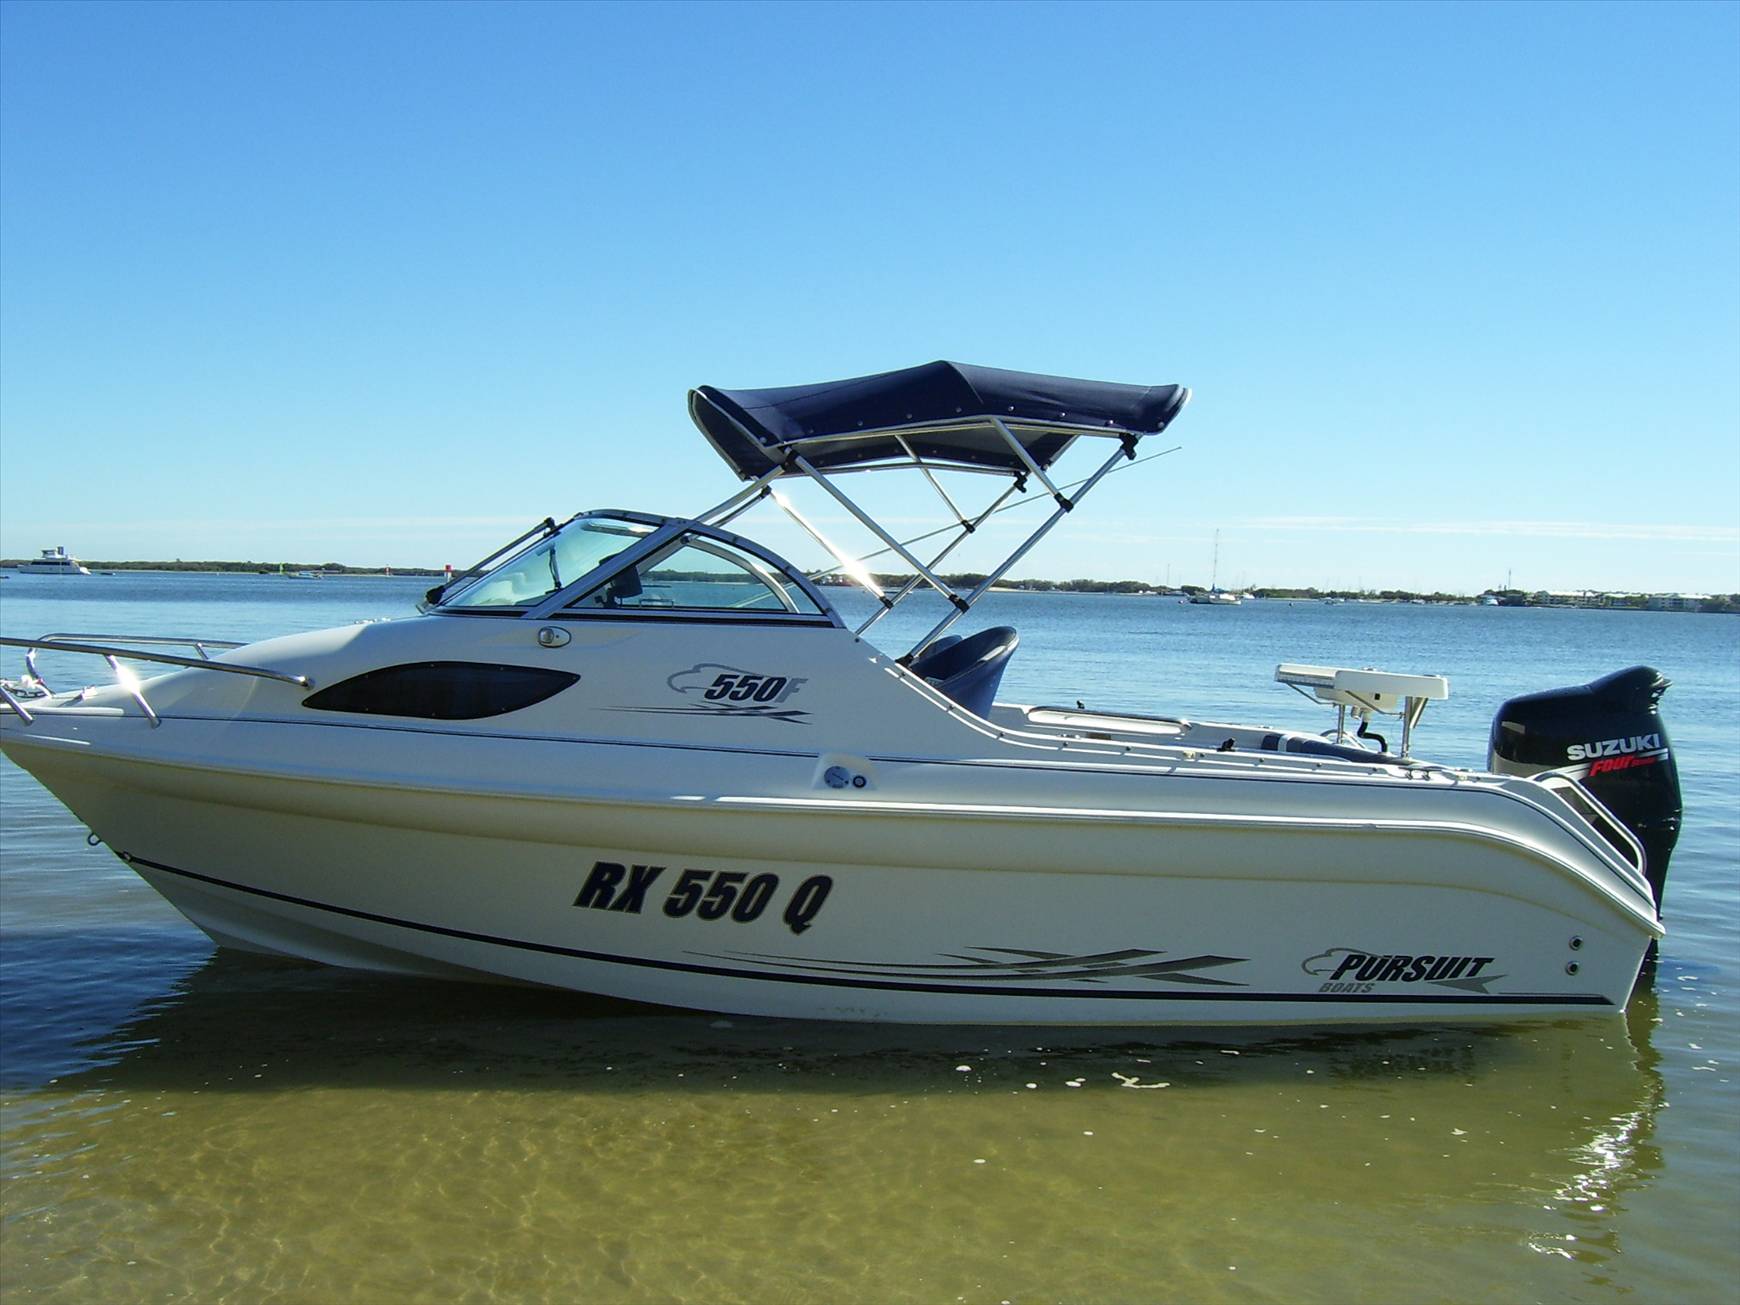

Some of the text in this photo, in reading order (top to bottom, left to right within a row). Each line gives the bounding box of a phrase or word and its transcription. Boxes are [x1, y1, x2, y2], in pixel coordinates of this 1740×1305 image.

[704, 673, 809, 703] 550F
[1566, 733, 1660, 761] SUZUKI
[572, 861, 833, 936] RX 550 Q
[1329, 954, 1496, 983] PURSUIT
[1318, 982, 1375, 994] BOATS
